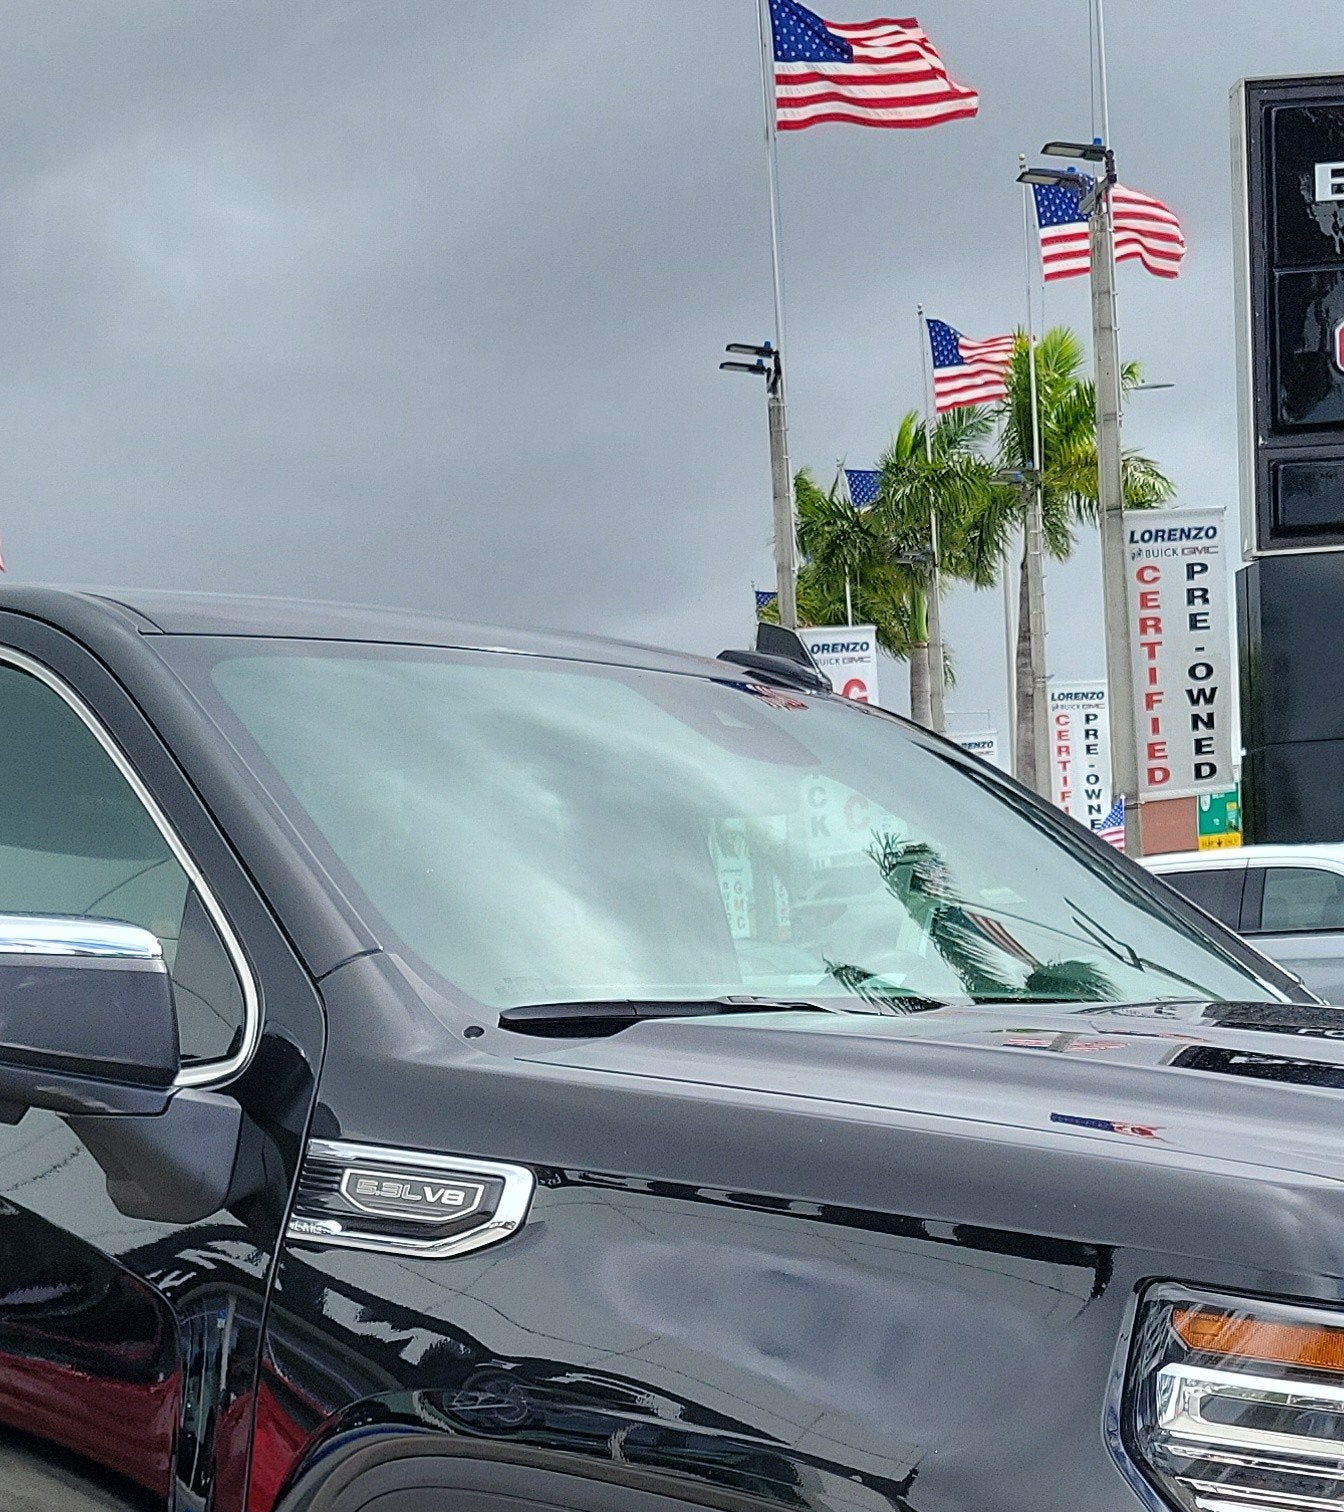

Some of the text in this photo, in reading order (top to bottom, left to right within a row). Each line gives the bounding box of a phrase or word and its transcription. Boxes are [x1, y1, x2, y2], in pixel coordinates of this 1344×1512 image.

[1129, 526, 1218, 544] LORENZO
[1145, 545, 1219, 559] BUICK GMC
[810, 641, 870, 655] ORENZO
[817, 658, 841, 666] UICK
[1136, 565, 1171, 786] CERTIFIED
[1051, 691, 1105, 701] LORENZO
[1055, 713, 1072, 816] CERTIFI
